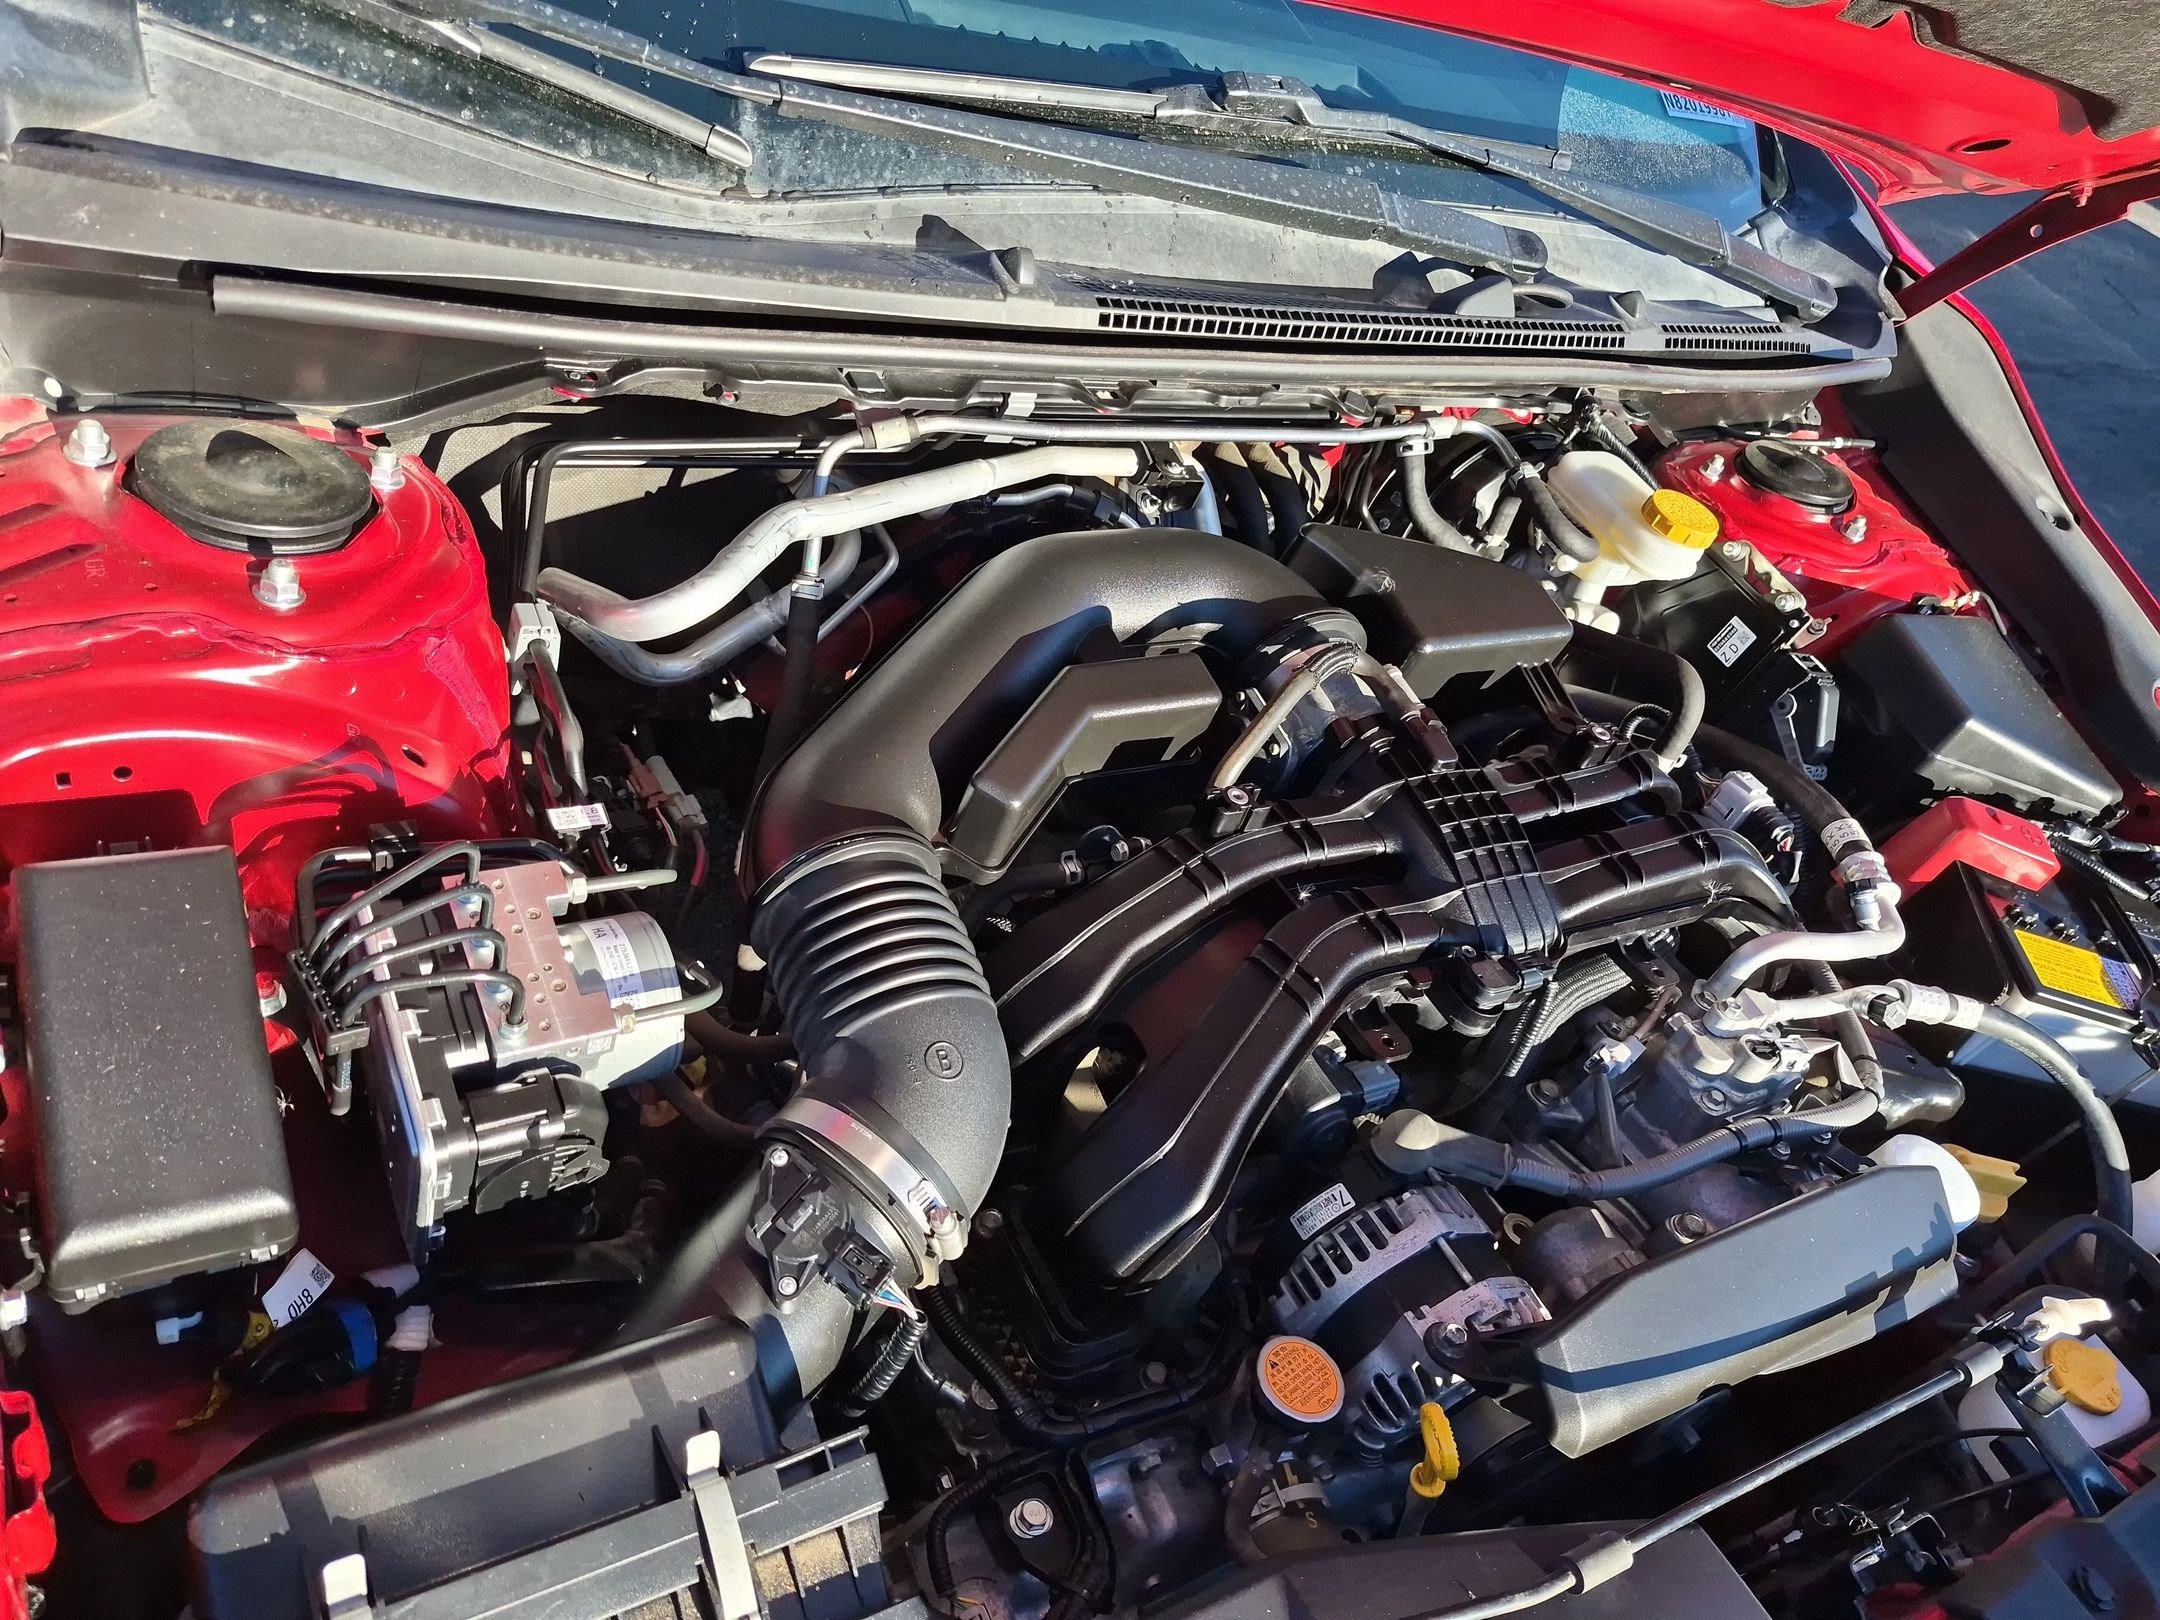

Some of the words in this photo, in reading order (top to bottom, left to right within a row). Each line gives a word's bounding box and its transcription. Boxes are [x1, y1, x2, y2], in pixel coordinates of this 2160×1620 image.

[1720, 651, 1732, 664] Z
[1728, 643, 1739, 654] D
[287, 1288, 314, 1320] 8HD
[1290, 1373, 1301, 1383] OPEN
[1301, 1363, 1313, 1374] WHEN
[1312, 1357, 1320, 1365] HOT
[1305, 1510, 1318, 1529] S
